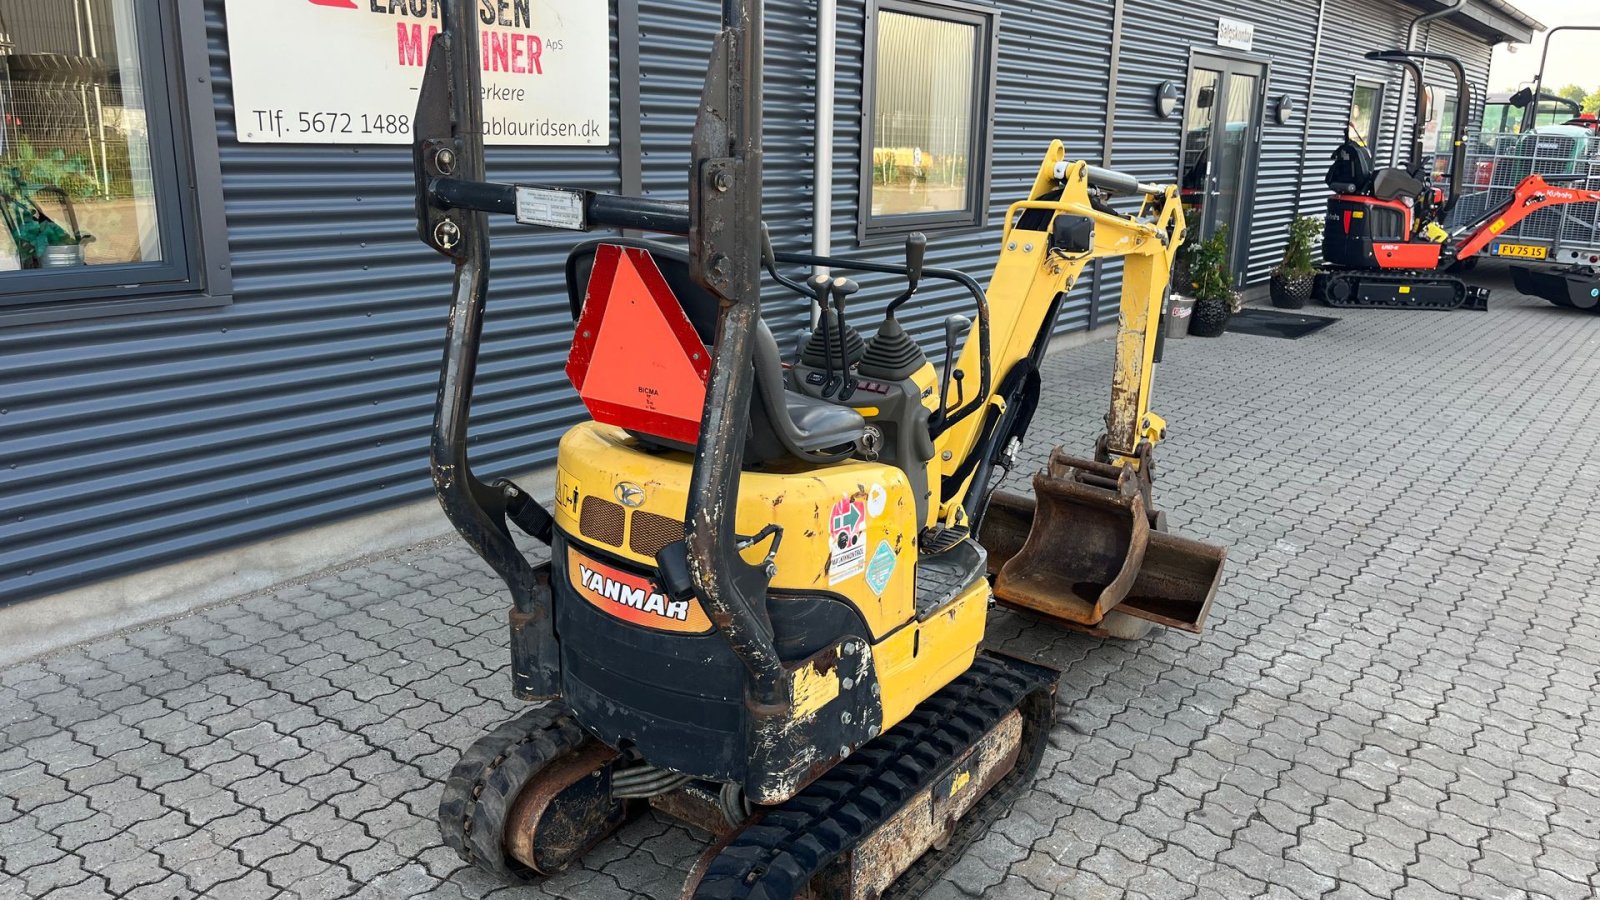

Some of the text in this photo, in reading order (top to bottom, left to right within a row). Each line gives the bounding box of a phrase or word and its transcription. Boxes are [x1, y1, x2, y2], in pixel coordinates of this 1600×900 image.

[545, 38, 564, 52] ApS
[252, 109, 410, 138] Tlf. 5672 1488
[482, 117, 600, 137] ablauridsen.dk
[1502, 245, 1542, 256] FV 75 15
[638, 386, 659, 396] BICMA
[579, 563, 690, 622] YANMAR
